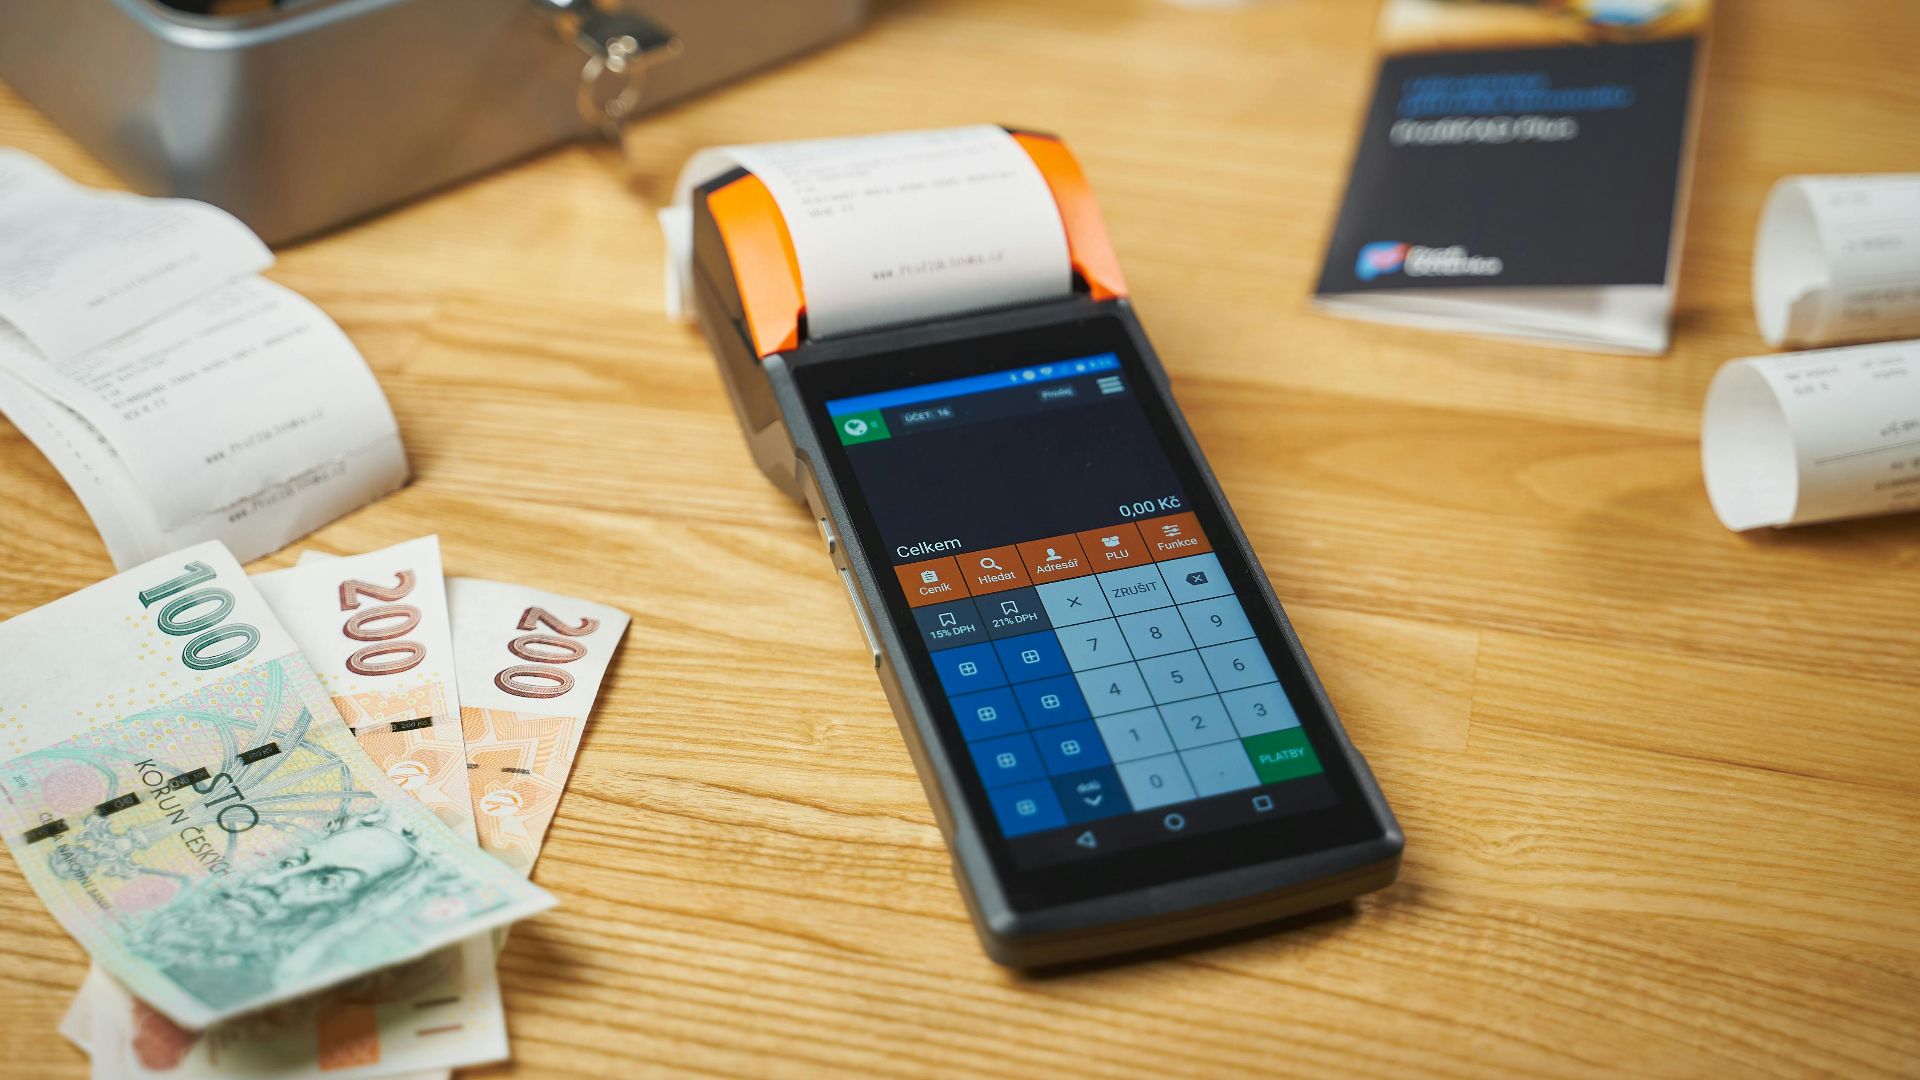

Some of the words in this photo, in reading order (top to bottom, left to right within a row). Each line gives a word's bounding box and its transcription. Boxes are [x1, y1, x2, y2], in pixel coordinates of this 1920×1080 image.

[1118, 500, 1156, 519] 0,00
[1158, 495, 1181, 511] Kč
[896, 535, 962, 559] Celkem
[1157, 535, 1198, 552] Funkce
[1104, 549, 1129, 562] PLU
[1036, 557, 1079, 575] Adresář
[977, 570, 1016, 586] Hledat
[918, 580, 952, 597] Ceník
[1110, 579, 1159, 599] ZRUŠIT
[138, 561, 261, 671] 100
[339, 569, 427, 676] 200
[991, 615, 1013, 628] 21%
[1014, 611, 1038, 624] DPH
[1210, 614, 1224, 628] 9
[929, 627, 951, 640] 15%
[952, 622, 976, 636] DPH
[1149, 626, 1163, 641] 8
[495, 606, 600, 700] 200
[1086, 637, 1100, 653] 7
[1232, 658, 1246, 673] 6
[1171, 669, 1185, 684] 5
[1108, 682, 1122, 697] 4
[1253, 703, 1267, 718] 3
[1190, 715, 1207, 731] 2
[1128, 728, 1140, 743] 1
[1258, 747, 1306, 767] PLATBY
[1149, 774, 1164, 790] 0
[192, 772, 259, 834] STO
[134, 758, 190, 825] KORUN
[180, 825, 236, 877] ČESKÝCH
